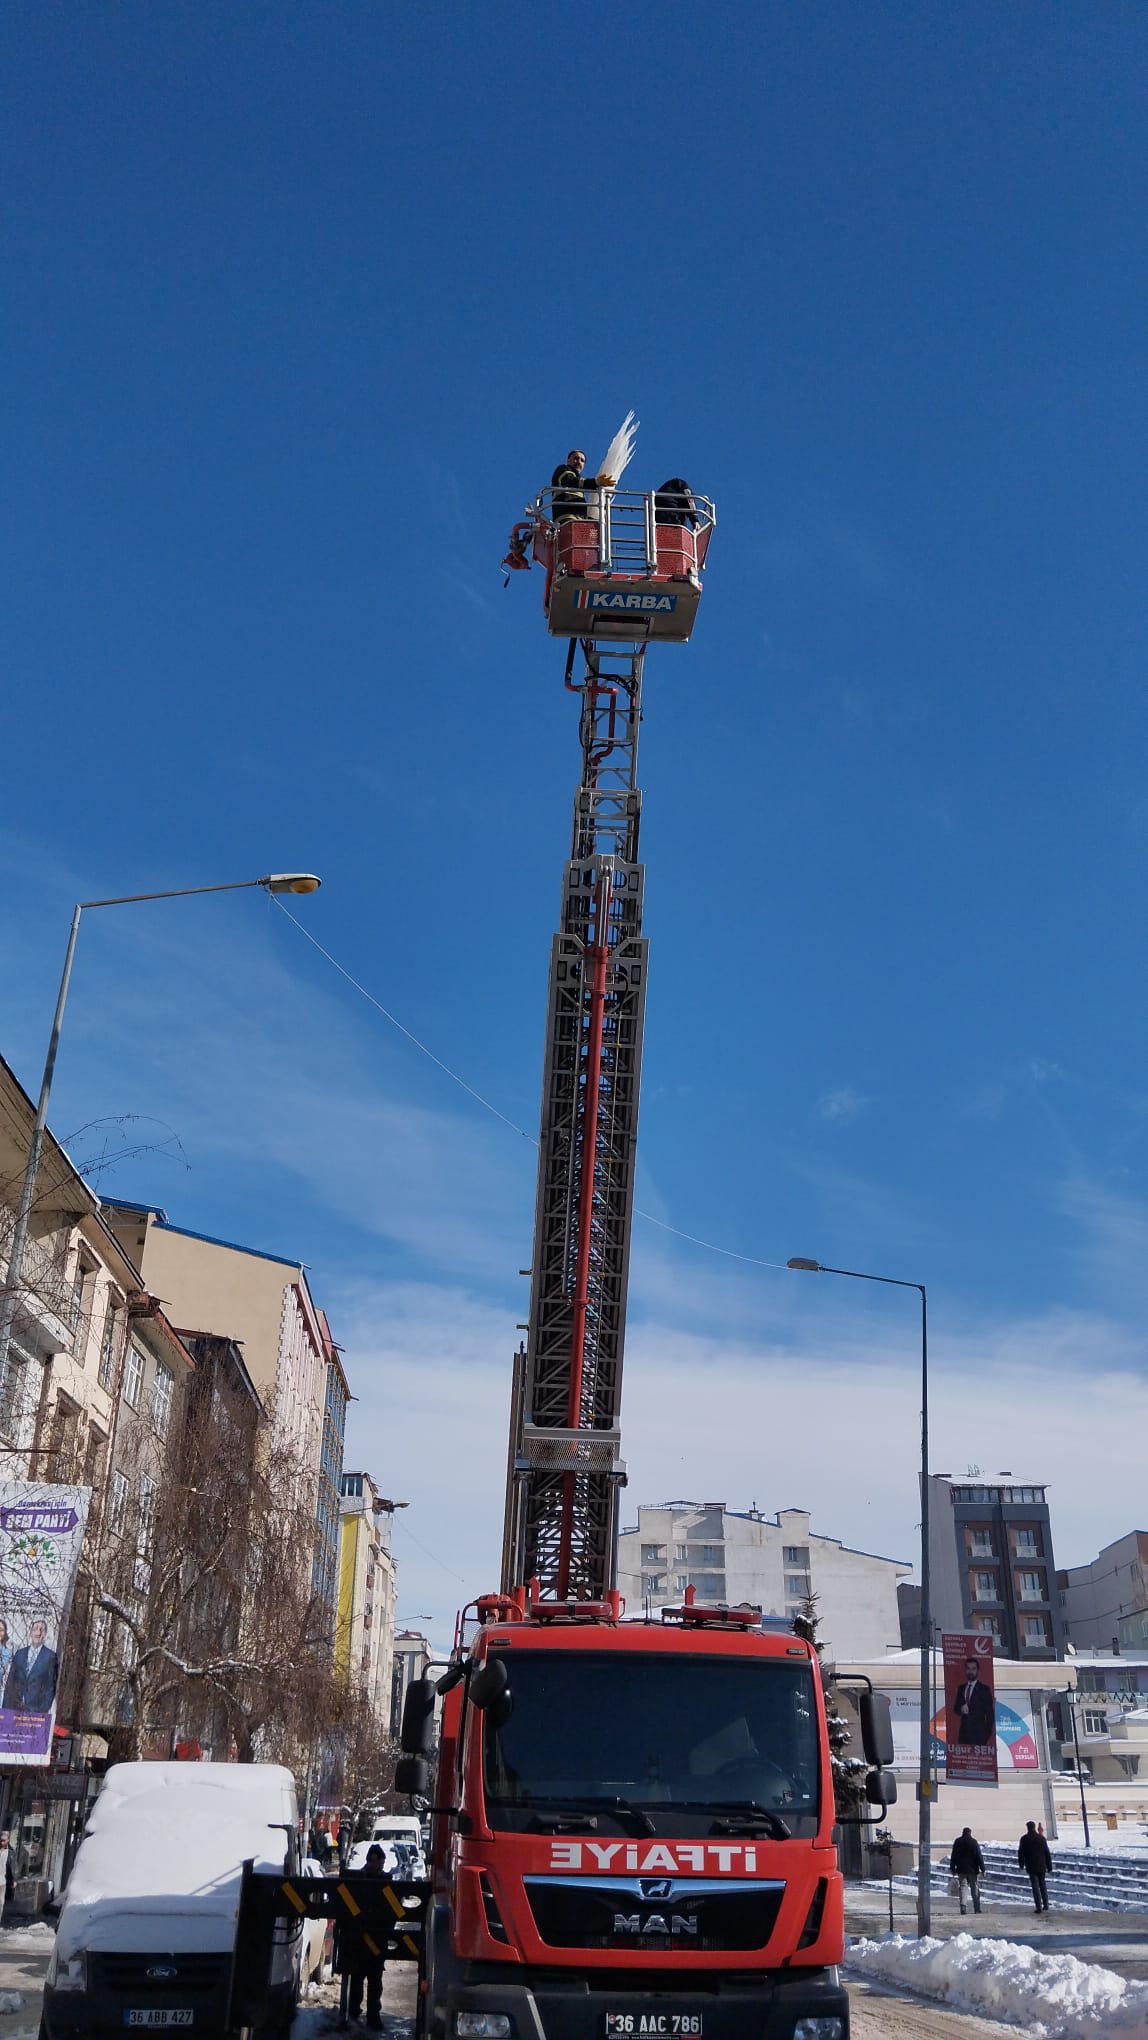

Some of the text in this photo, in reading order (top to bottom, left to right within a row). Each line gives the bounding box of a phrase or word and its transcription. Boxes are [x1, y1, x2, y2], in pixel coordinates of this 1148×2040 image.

[592, 593, 672, 610] KARBA
[613, 1914, 698, 1934] MAN
[130, 2011, 192, 2023] 36 ABB 427
[615, 2014, 700, 2033] 36 AAC 786
